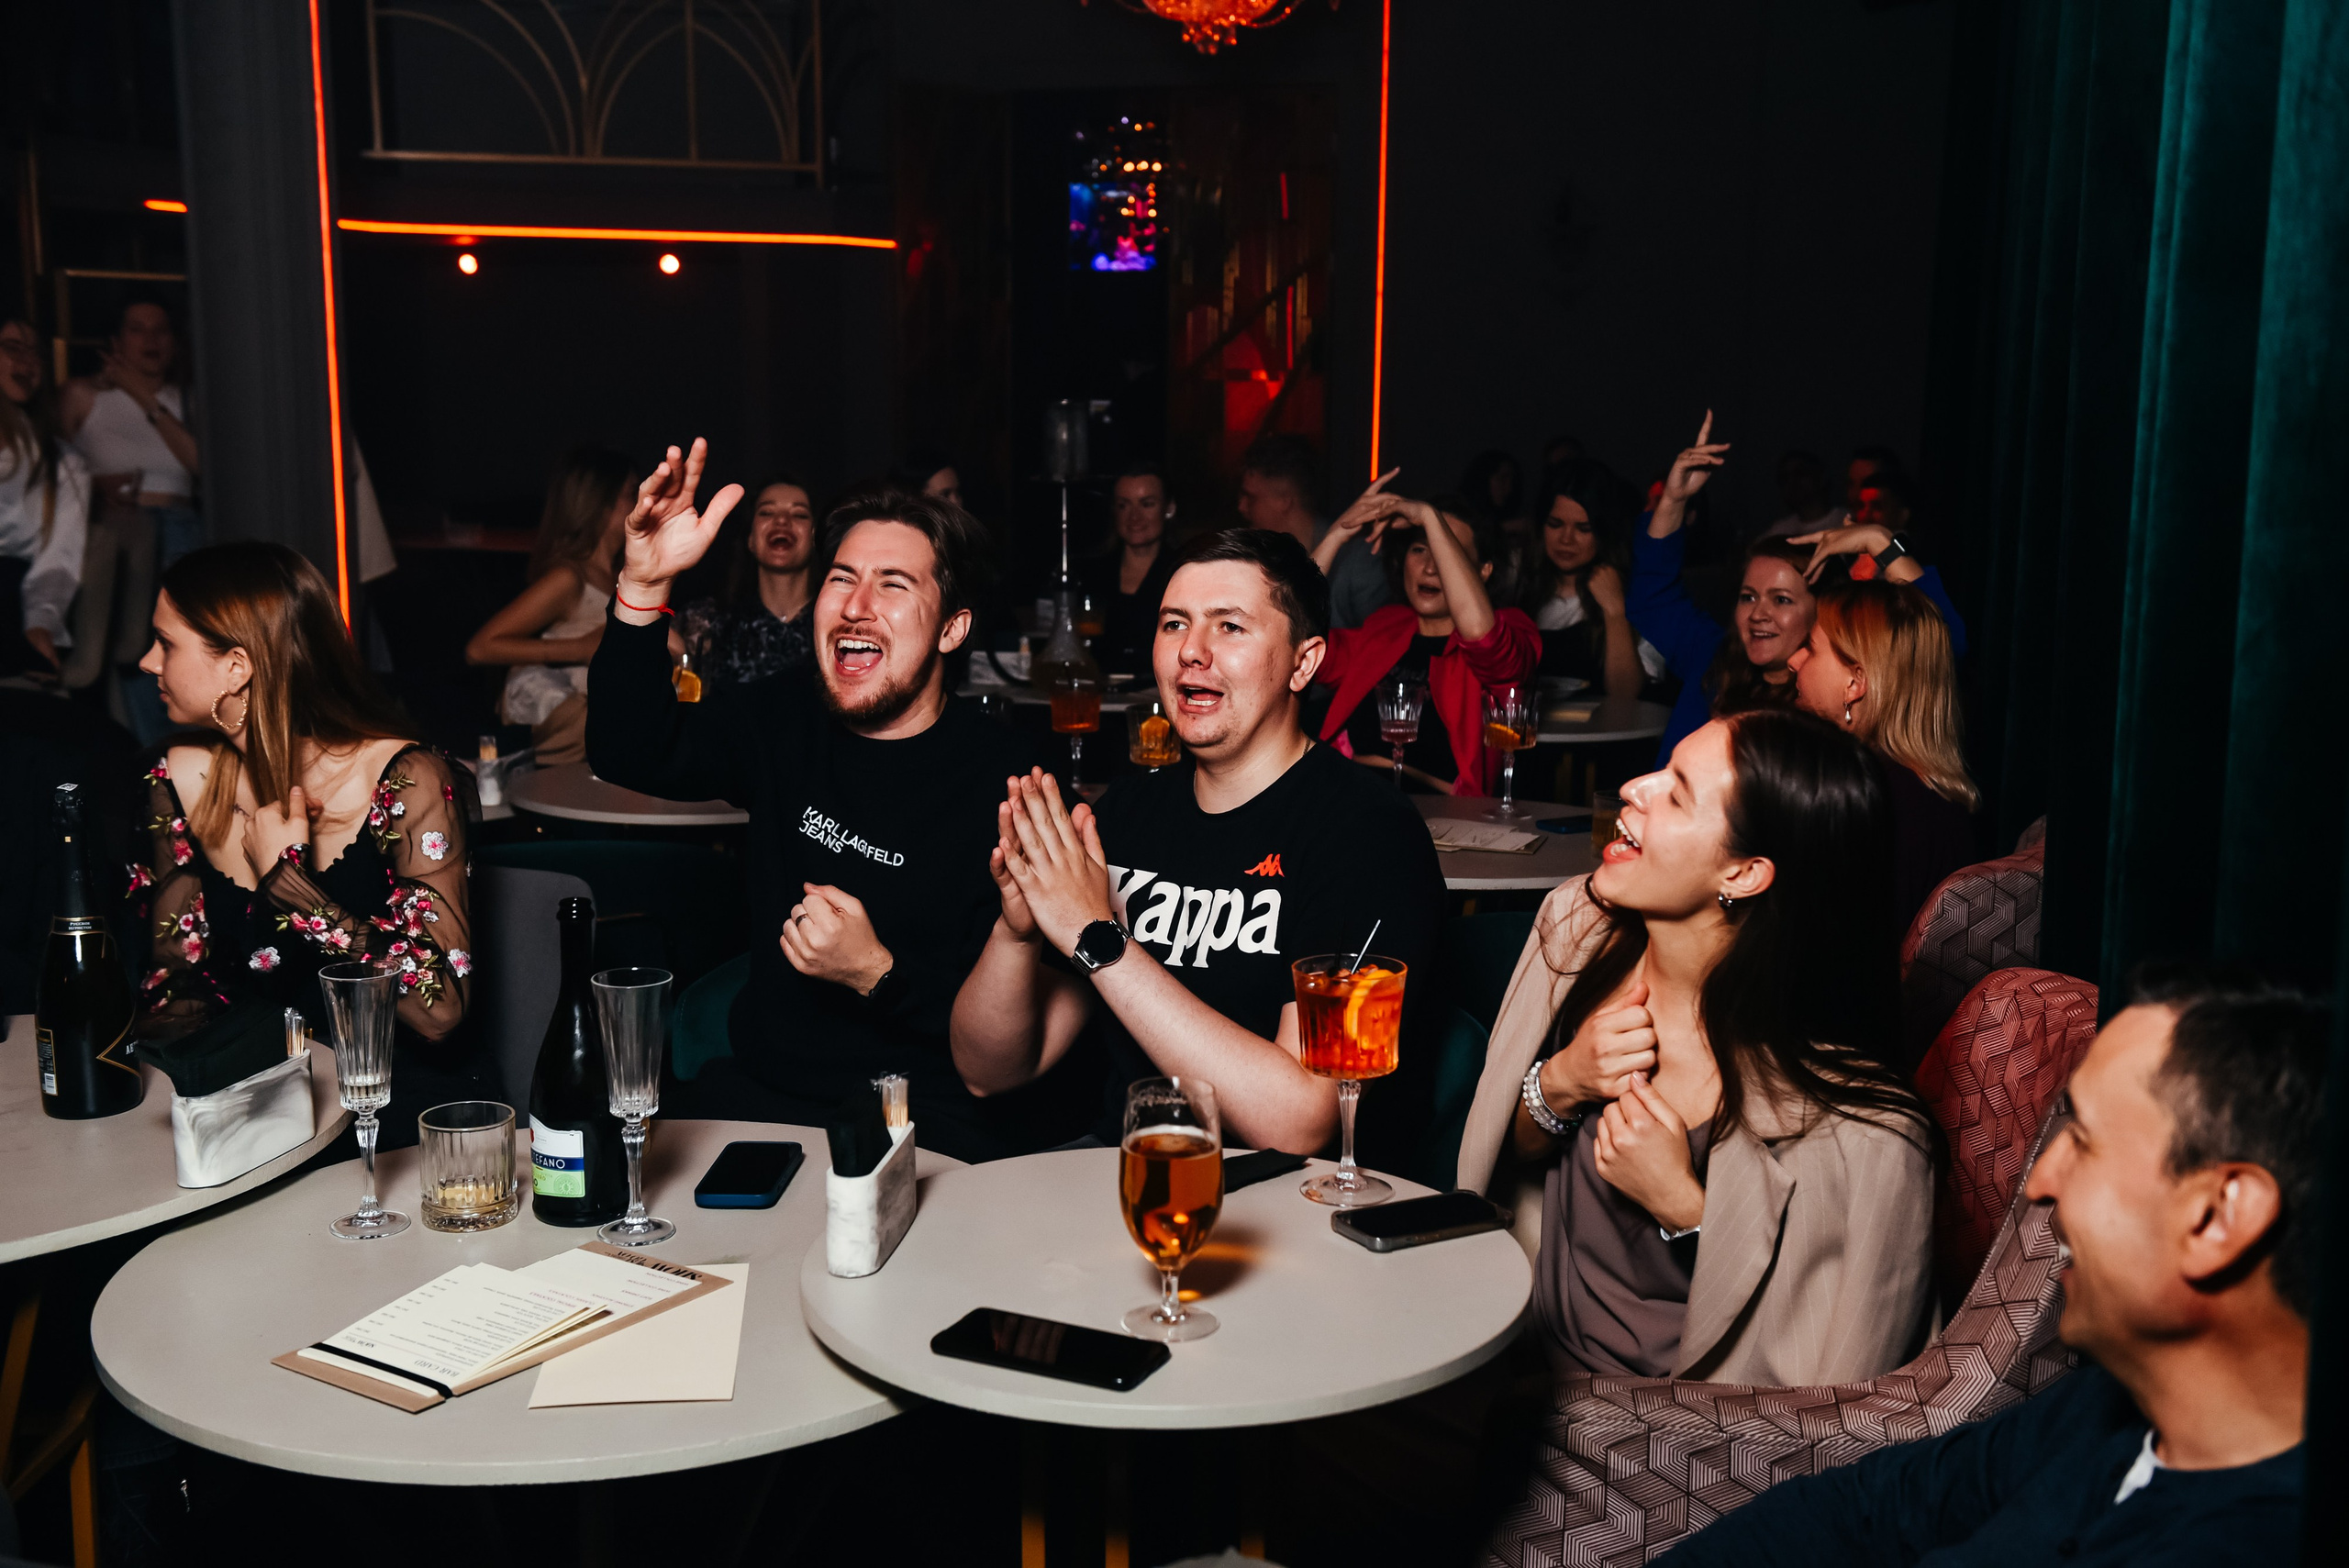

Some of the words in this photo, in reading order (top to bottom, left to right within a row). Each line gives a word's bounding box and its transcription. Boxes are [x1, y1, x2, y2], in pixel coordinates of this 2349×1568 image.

[798, 819, 844, 853] JEANS
[802, 806, 840, 839] KARL
[840, 828, 905, 867] LAGFELD
[1107, 864, 1282, 968] Kappa
[532, 1151, 565, 1169] EFANO
[415, 1359, 439, 1373] CARD
